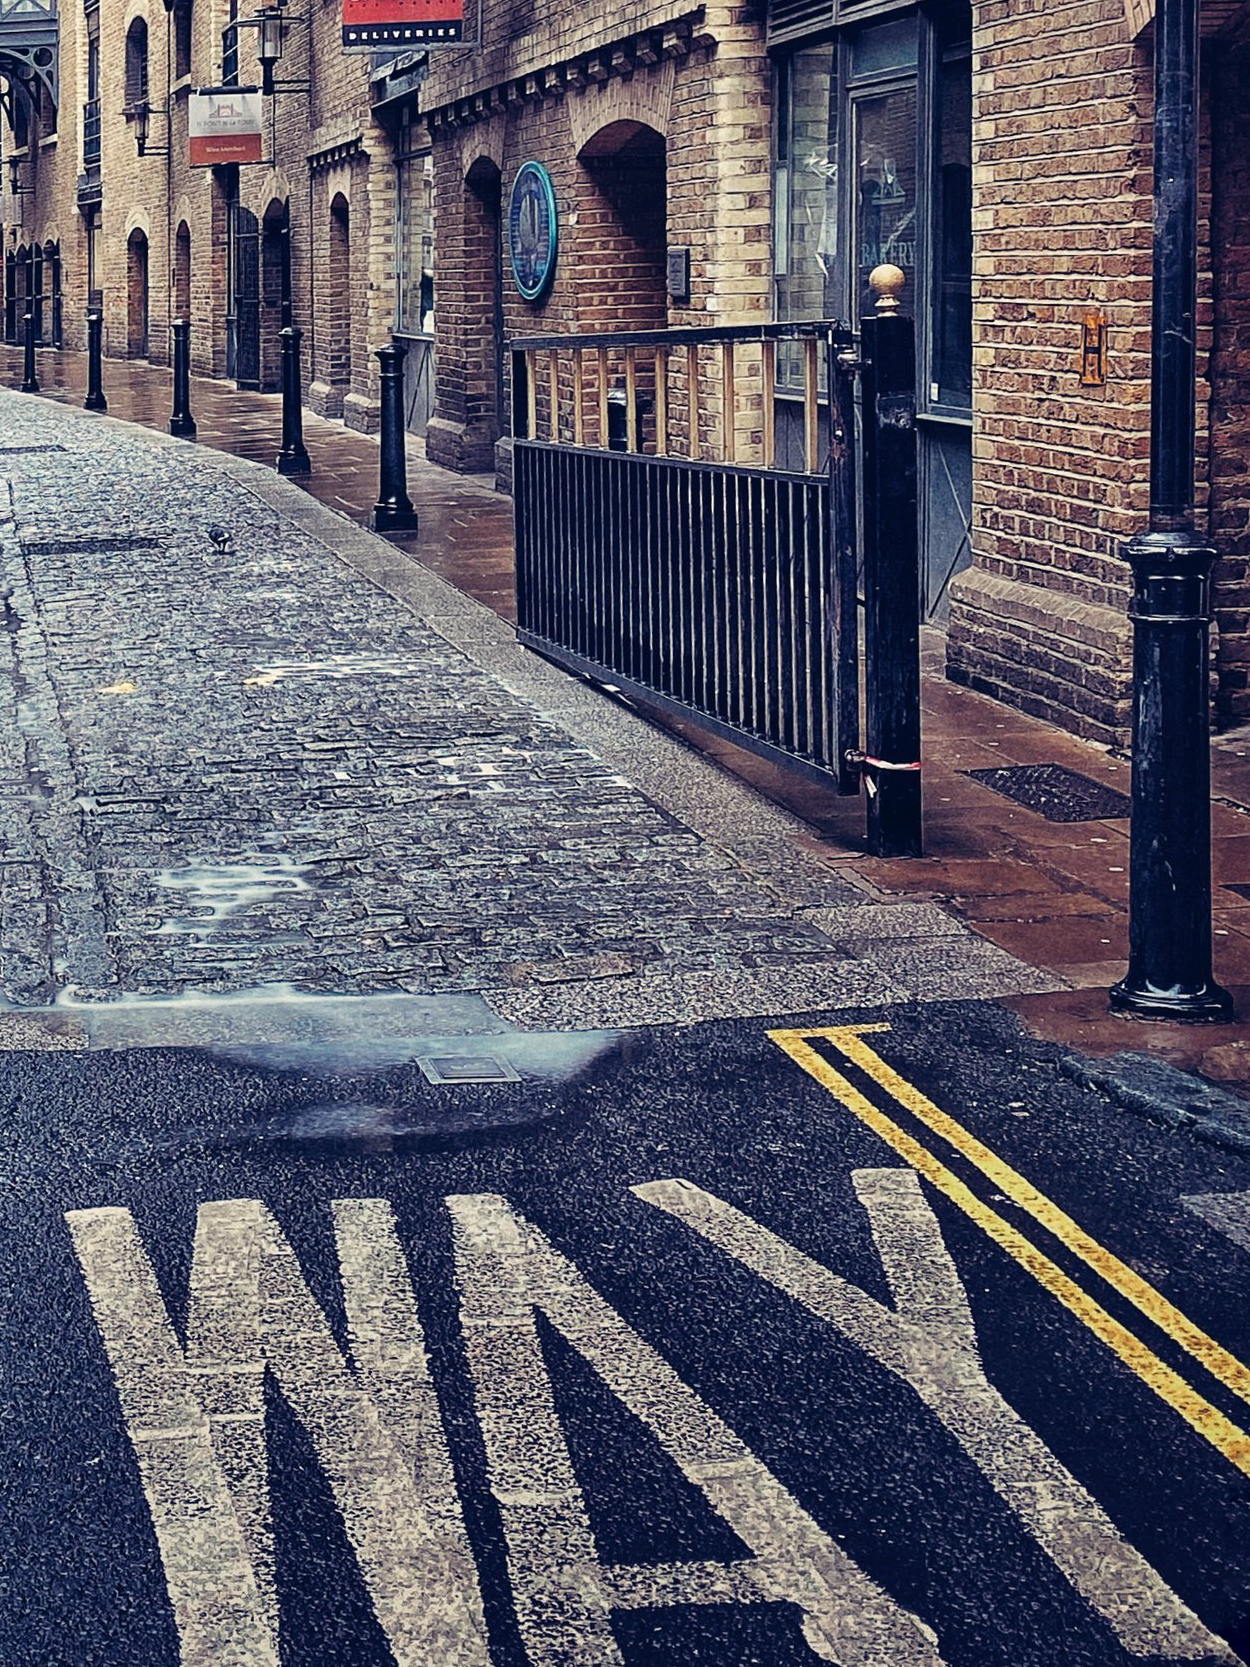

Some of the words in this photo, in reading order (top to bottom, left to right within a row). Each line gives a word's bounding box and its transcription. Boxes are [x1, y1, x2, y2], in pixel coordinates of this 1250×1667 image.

[349, 28, 456, 40] DELIVERIES
[861, 241, 917, 267] BAKERY
[63, 1168, 1247, 1667] WAY
